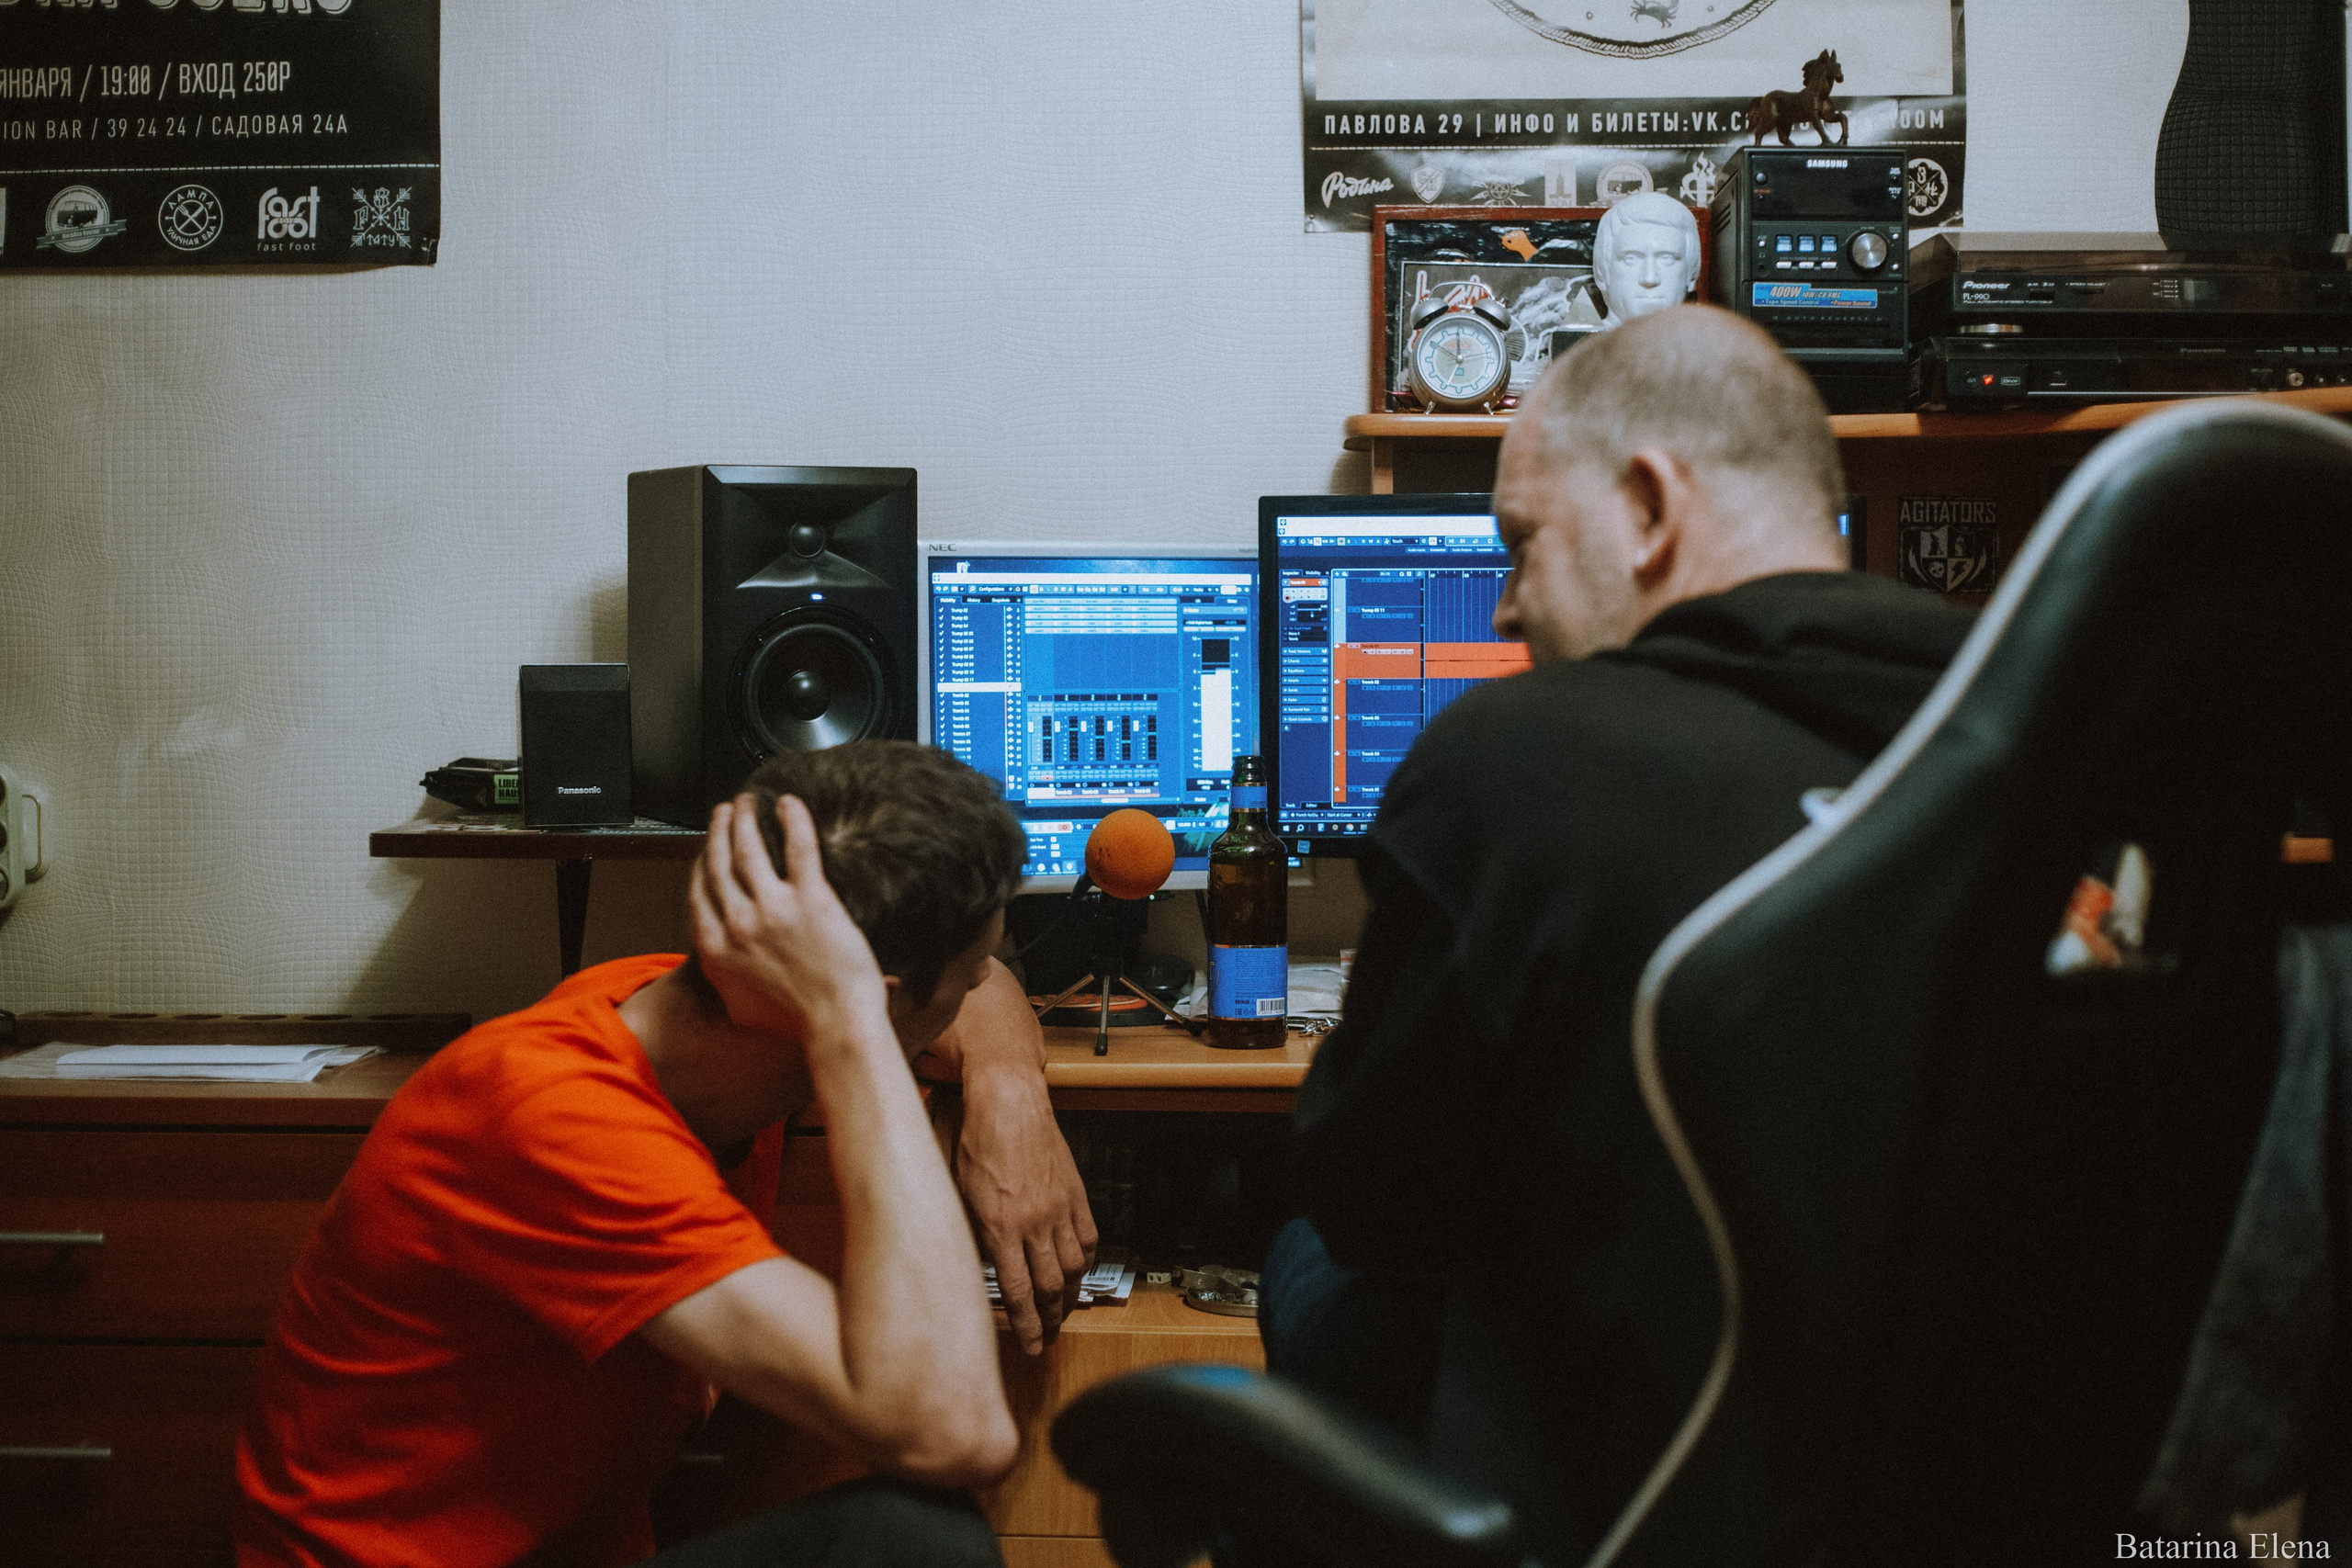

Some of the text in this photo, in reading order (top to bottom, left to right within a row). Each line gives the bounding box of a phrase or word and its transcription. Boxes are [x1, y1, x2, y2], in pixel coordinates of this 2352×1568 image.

[100, 64, 151, 96] 19:00
[179, 62, 236, 99] ВХОД
[46, 119, 82, 139] BAR
[107, 118, 128, 138] 39
[137, 118, 157, 137] 24
[166, 117, 186, 137] 24
[211, 114, 303, 139] САДОВАЯ
[1324, 114, 1426, 135] ПАВЛОВА
[1438, 114, 1464, 134] 29
[1494, 113, 1555, 133] ИНФО
[1566, 113, 1579, 133] И
[1806, 159, 1849, 169] SAMSUNG
[1320, 171, 1395, 209] Родина
[168, 188, 215, 210] ЛАМПА
[257, 242, 317, 252] fast foot
[1962, 280, 2010, 290] Pioneer
[1770, 286, 1803, 299] 400W
[1962, 292, 1990, 300] PL-990
[1899, 500, 1996, 524] AGITATORS
[928, 543, 957, 552] NEC
[557, 785, 602, 795] Panasonic
